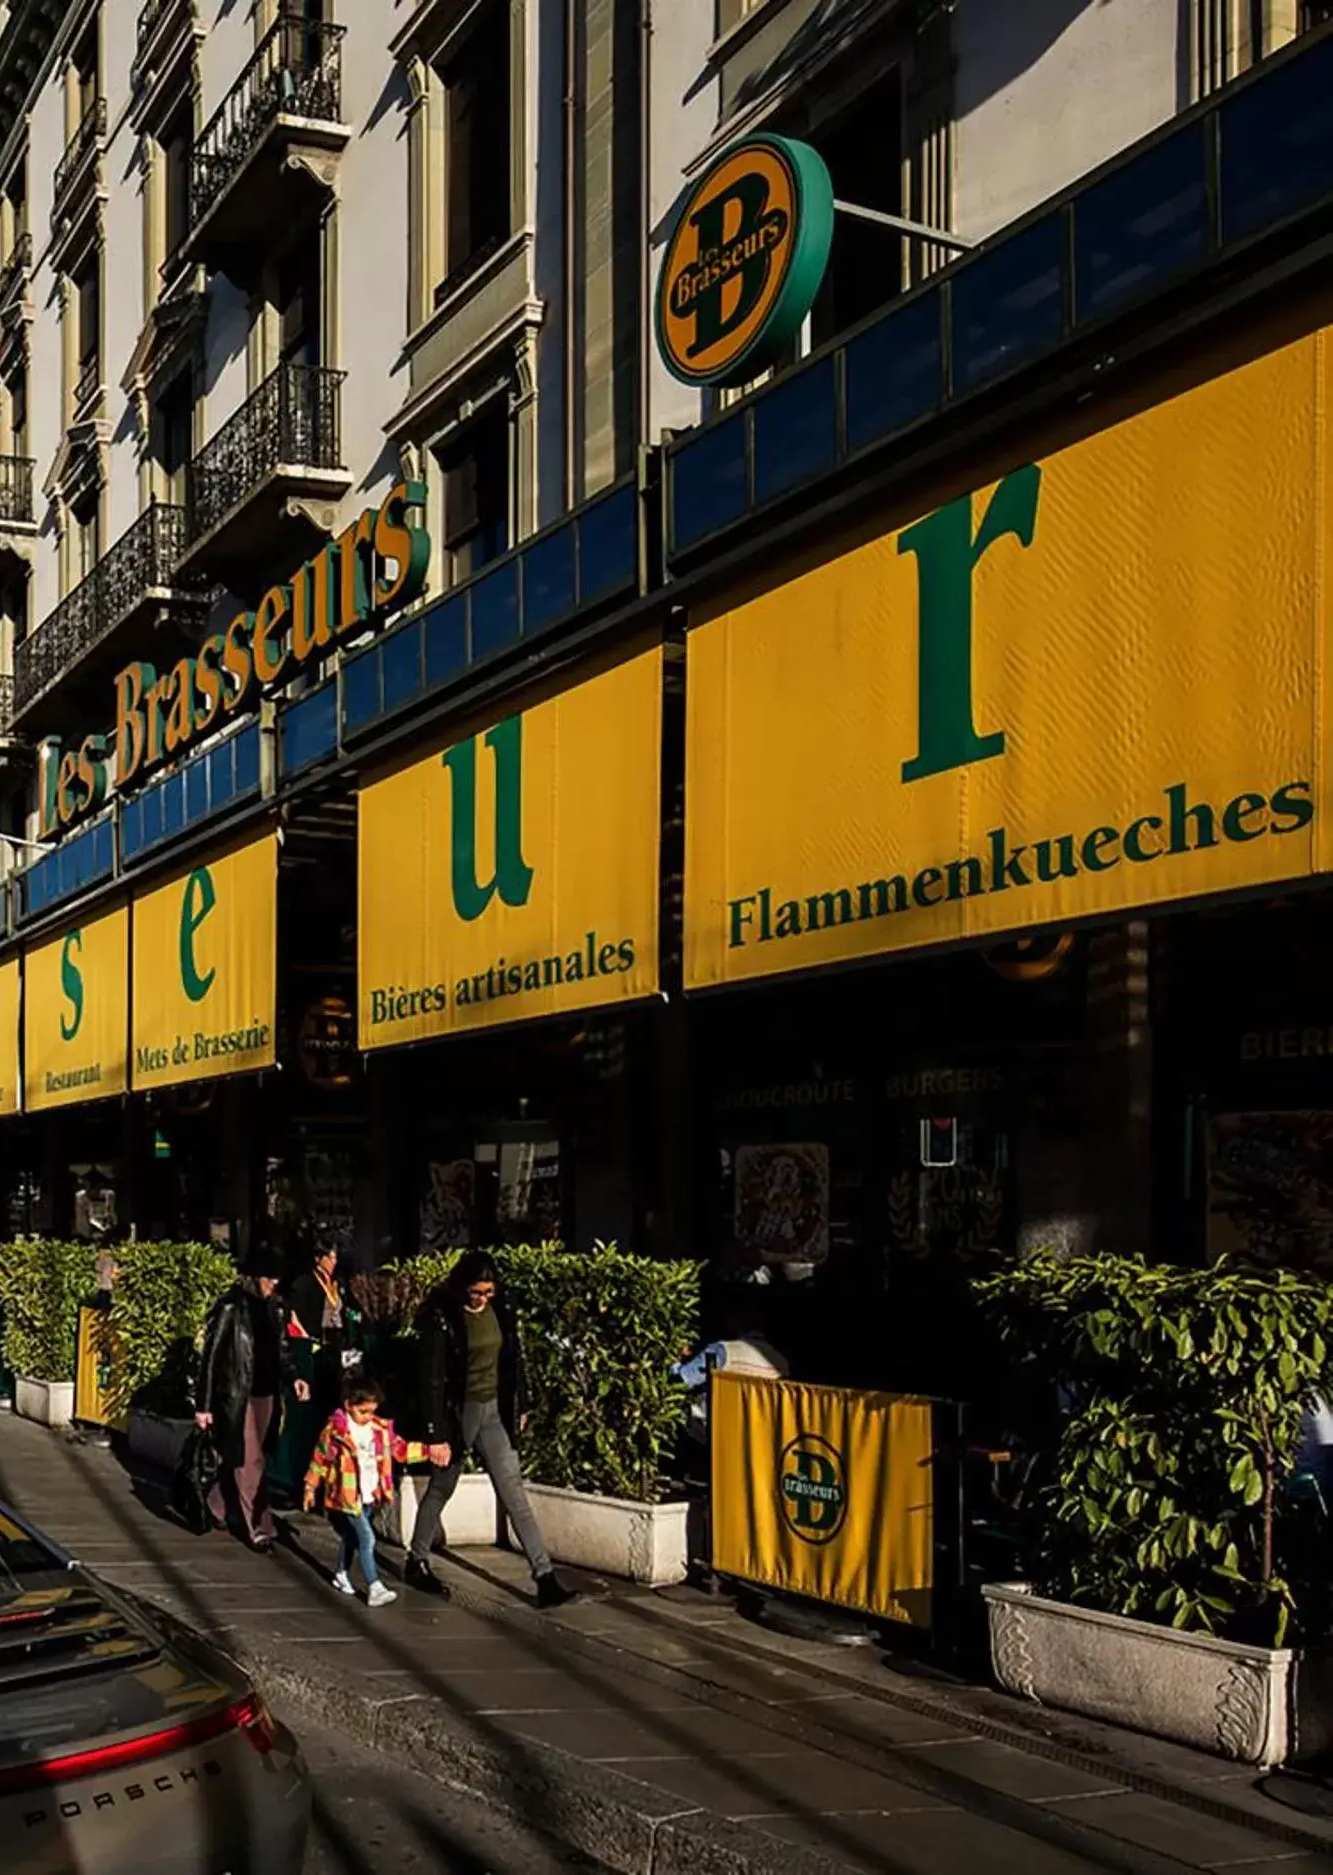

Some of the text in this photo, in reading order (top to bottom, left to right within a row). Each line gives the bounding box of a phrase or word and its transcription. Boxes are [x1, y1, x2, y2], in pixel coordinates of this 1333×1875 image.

[677, 223, 779, 309] Brasseurs
[114, 480, 431, 788] Brasseurs
[726, 780, 1315, 949] Flammenkueches
[370, 930, 635, 1025] Bières artisanales
[45, 1062, 101, 1093] Restaurant
[137, 1045, 170, 1074] Mets
[172, 1035, 190, 1065] de
[194, 1016, 270, 1063] Brasserie
[885, 1065, 1006, 1100] BURGERS
[22, 1759, 224, 1828] PORSCHE
